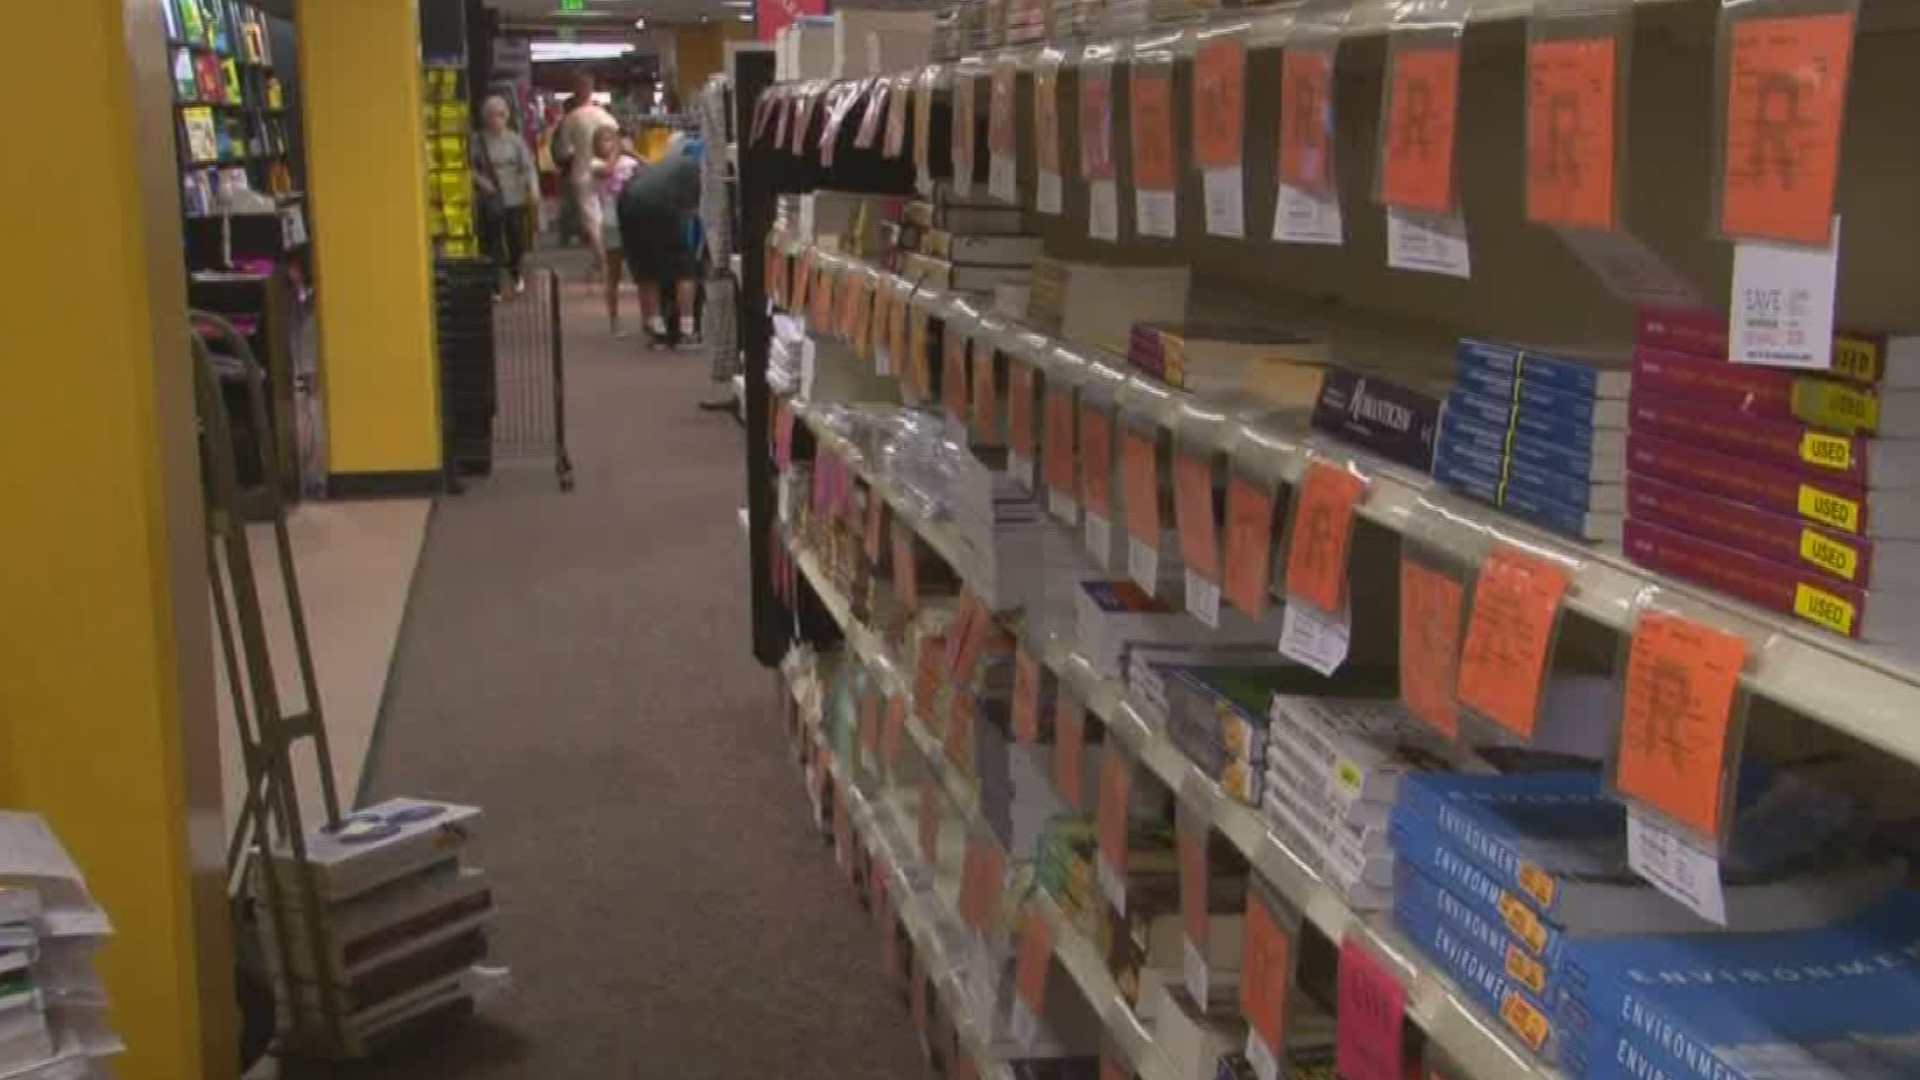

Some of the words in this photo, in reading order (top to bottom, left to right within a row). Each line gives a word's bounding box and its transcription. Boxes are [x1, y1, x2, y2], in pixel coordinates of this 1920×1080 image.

[1811, 440, 1846, 462] USED
[1813, 495, 1849, 523] USED
[1811, 539, 1847, 570] USED
[1808, 595, 1844, 625] USED
